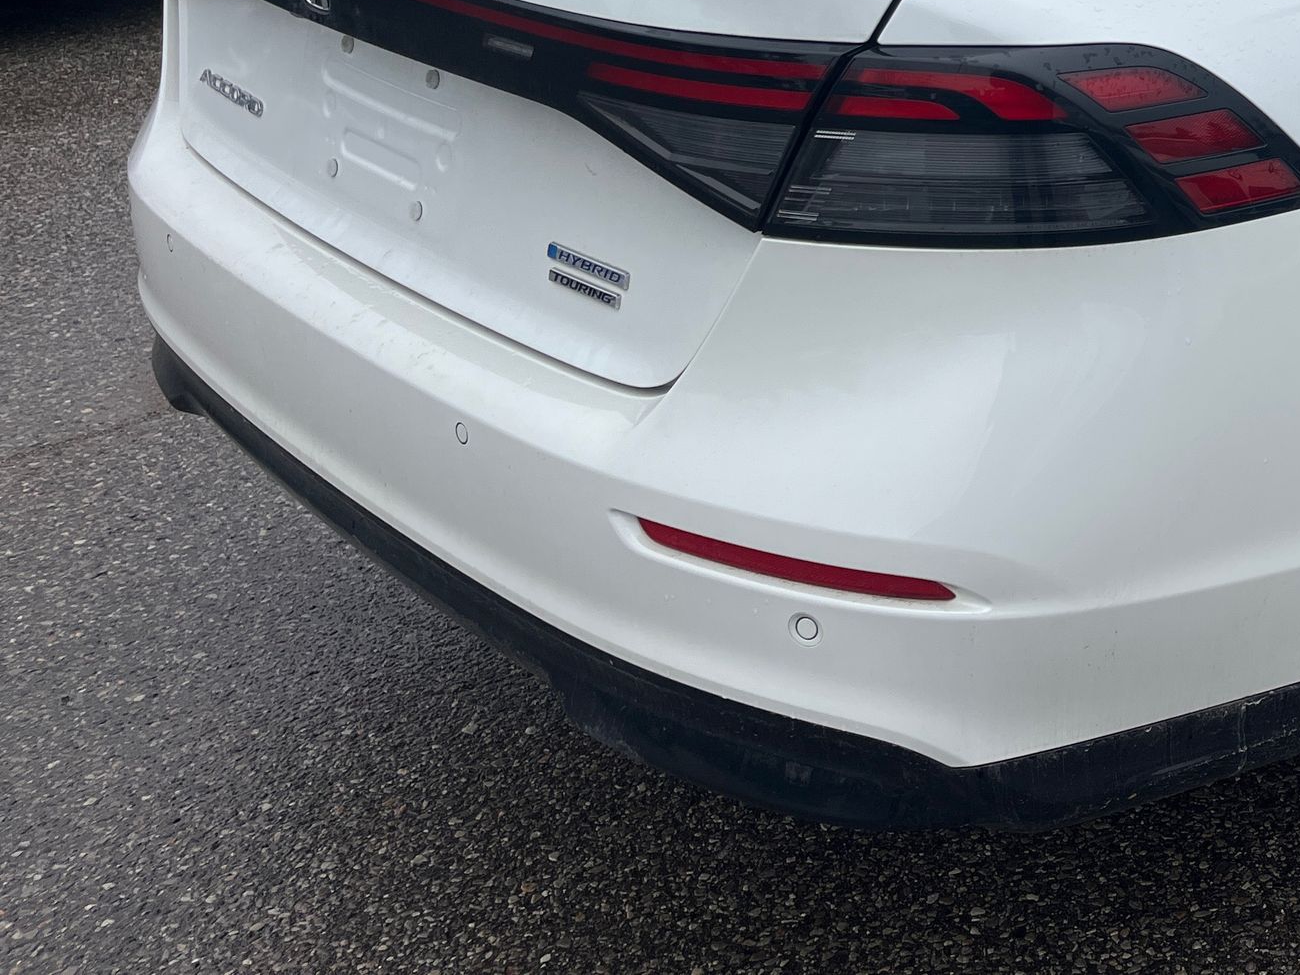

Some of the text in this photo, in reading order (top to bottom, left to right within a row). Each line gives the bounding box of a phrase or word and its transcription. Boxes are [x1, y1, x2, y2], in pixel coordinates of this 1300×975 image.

[200, 69, 263, 117] ACCORD
[558, 249, 621, 283] HYBRID
[552, 271, 614, 304] TOURING
